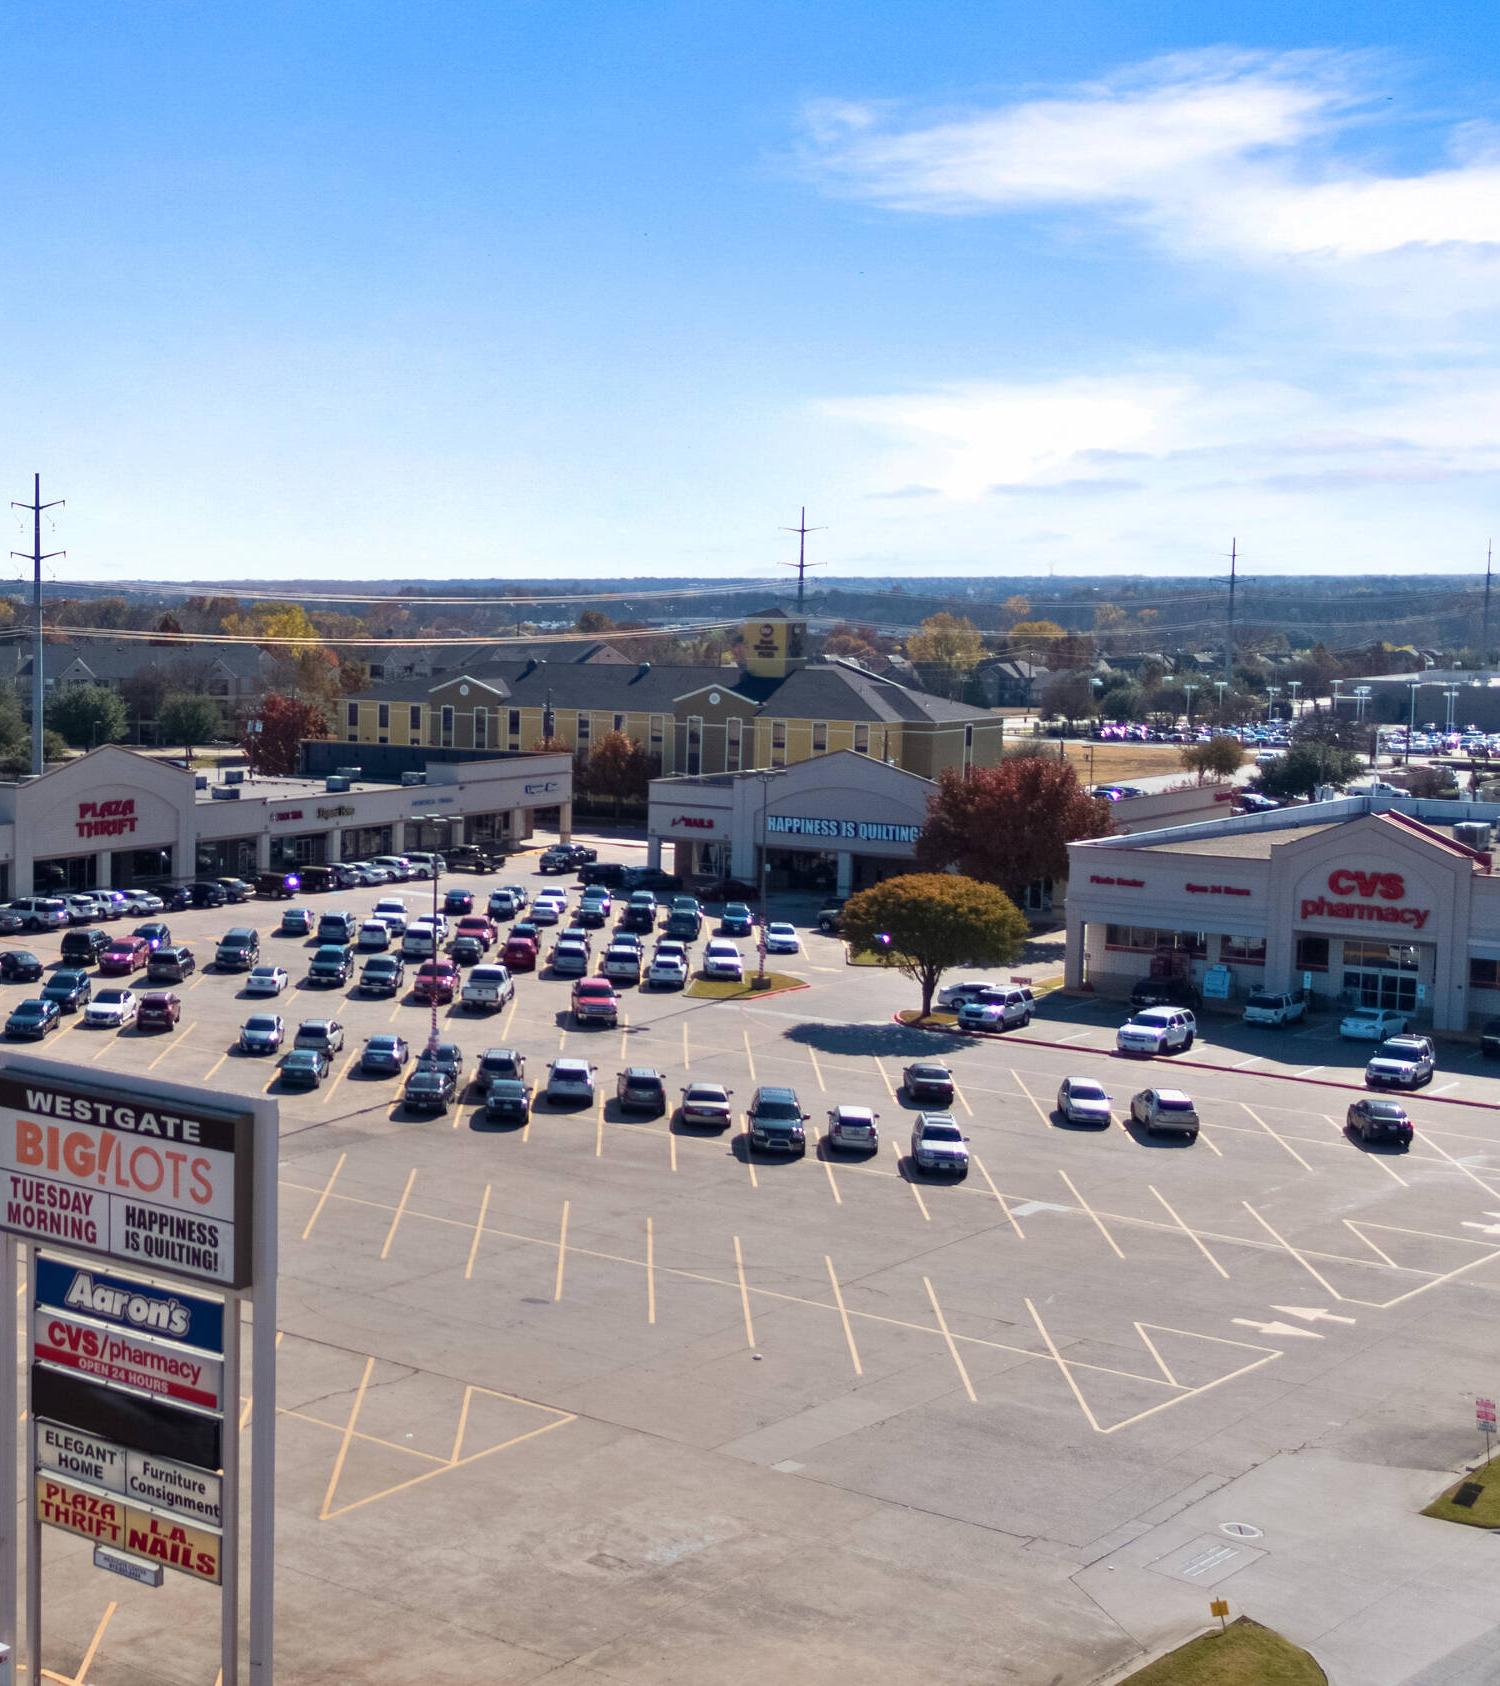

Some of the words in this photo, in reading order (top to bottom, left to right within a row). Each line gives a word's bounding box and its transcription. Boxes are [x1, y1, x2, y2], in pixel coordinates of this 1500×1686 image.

[78, 798, 135, 819] PLAZA
[767, 816, 838, 837] HAPPINESS
[841, 824, 855, 837] IS
[75, 817, 139, 838] THRIFT
[1328, 869, 1405, 901] CVS
[1300, 895, 1431, 930] pharmacy
[26, 1089, 201, 1142] WESTGATE
[10, 1176, 94, 1217] TUESDAY
[7, 1201, 97, 1245] MORNING
[125, 1204, 219, 1249] HAPPINESS
[124, 1230, 140, 1252] IS
[143, 1237, 219, 1273] QUILTING!
[65, 1271, 191, 1337] Aaron's
[78, 1359, 109, 1377] OPEN
[112, 1368, 126, 1382] 24
[128, 1371, 169, 1394] HOURS
[45, 1430, 118, 1465] ELEGANT
[58, 1453, 104, 1480] HOME
[143, 1461, 206, 1495] Furniture
[46, 1483, 116, 1521] PLAZA
[129, 1476, 221, 1519] Consignment
[40, 1500, 121, 1542] THRIFT
[150, 1520, 194, 1547] L.A.
[128, 1529, 215, 1576] NAILS
